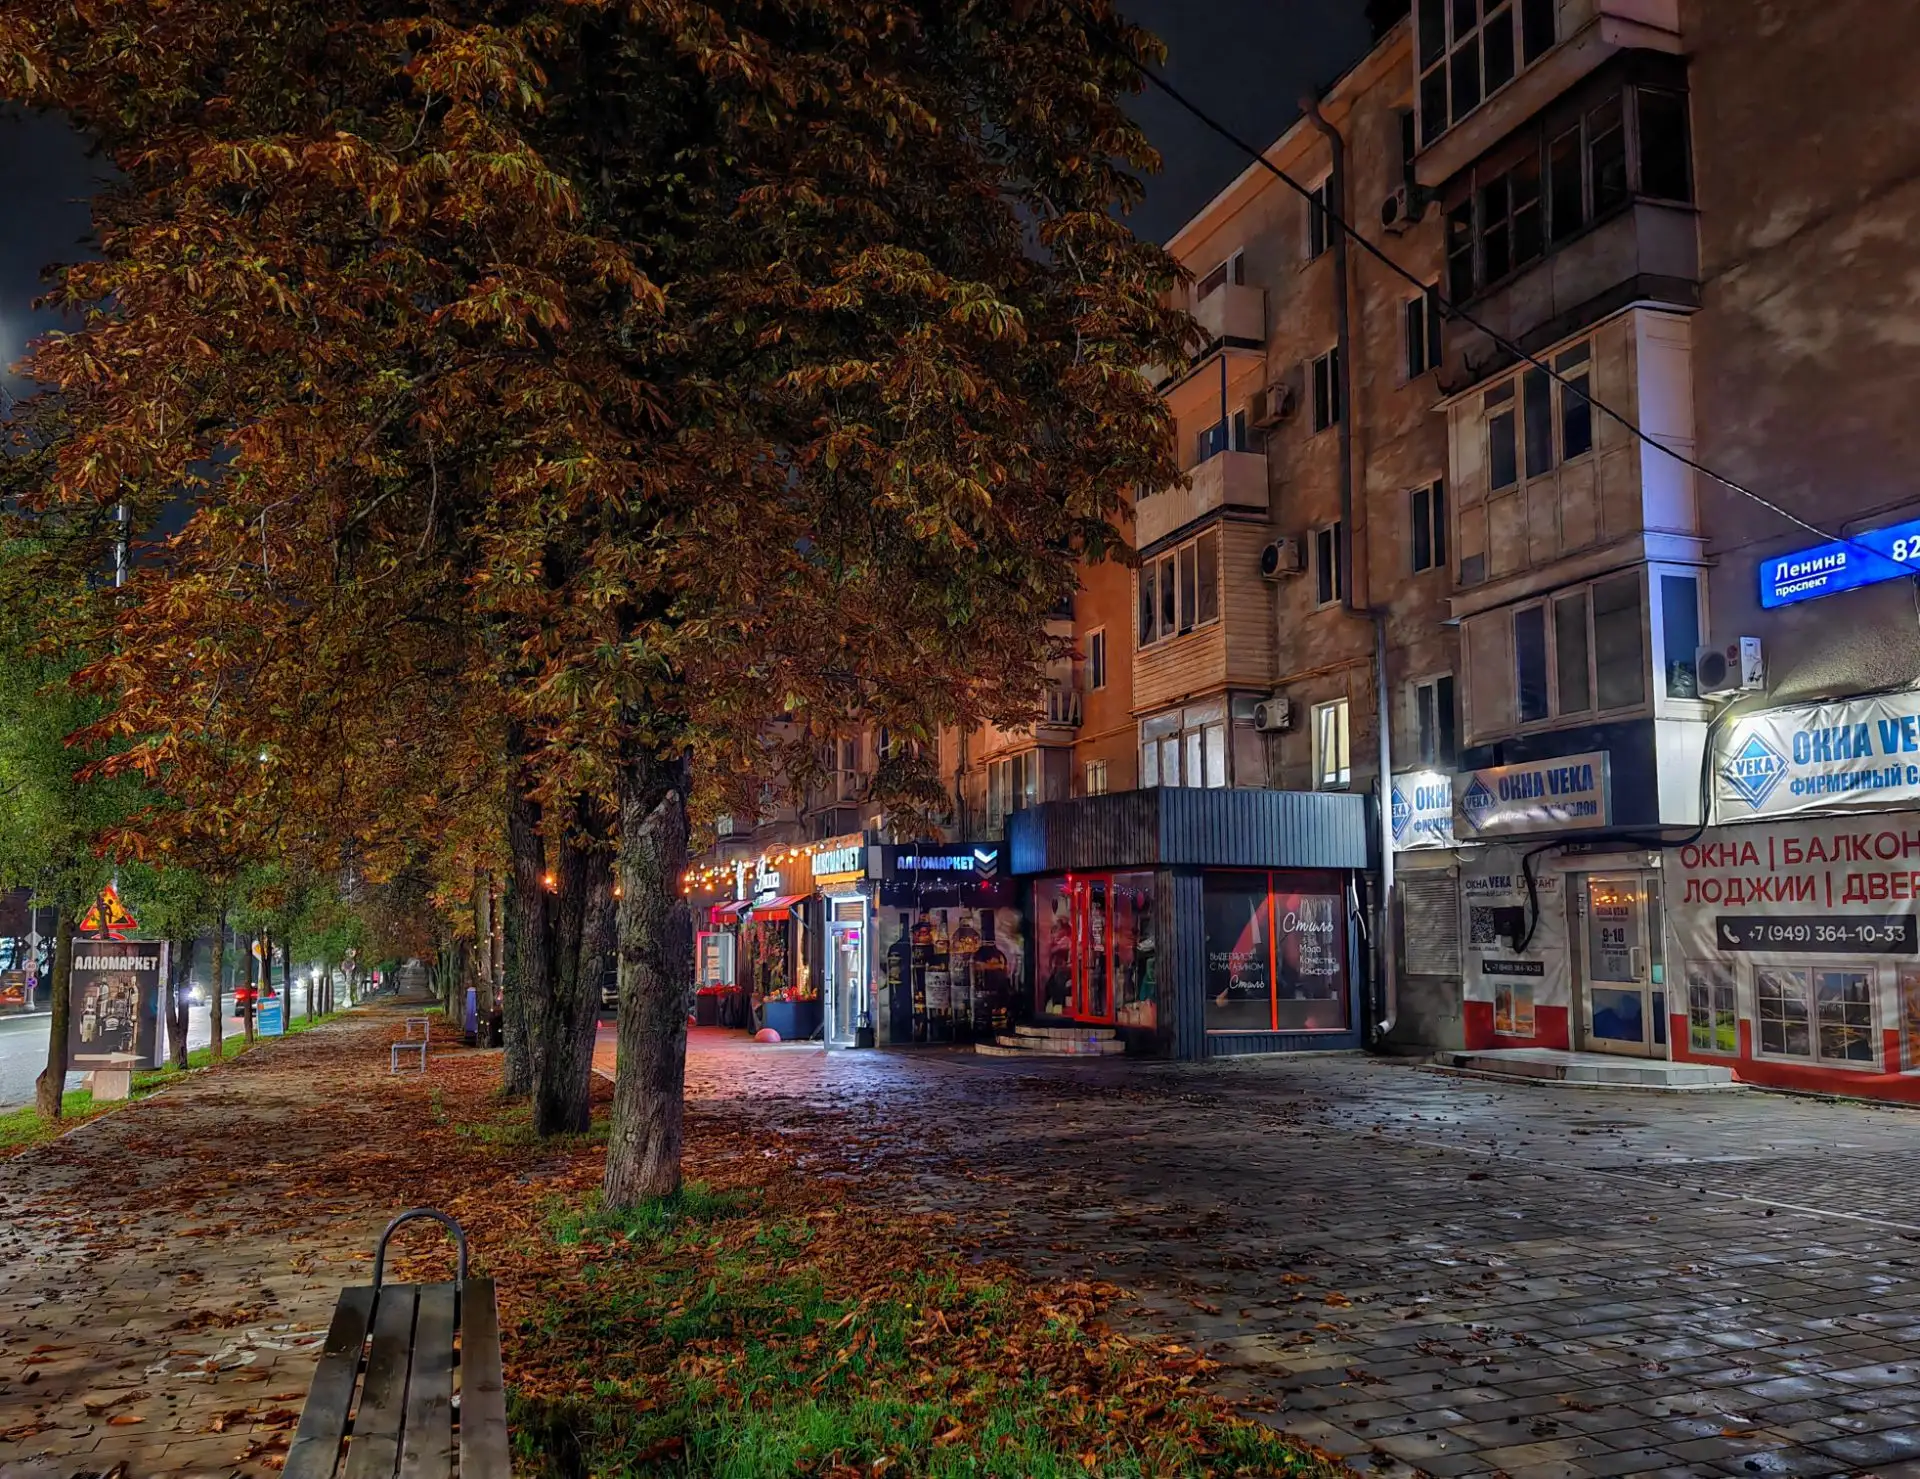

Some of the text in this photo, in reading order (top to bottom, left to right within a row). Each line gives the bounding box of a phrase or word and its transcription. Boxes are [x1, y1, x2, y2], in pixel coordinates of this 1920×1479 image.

[1893, 535, 1920, 562] 82
[1775, 552, 1847, 581] Ленина
[1775, 576, 1828, 597] проспект
[1792, 714, 1920, 766] ОКНА VE
[1735, 757, 1775, 777] VEKA
[1498, 763, 1595, 802] ОКНА VEKA
[1789, 763, 1902, 796] ФИРМЕННЫЙ
[1466, 793, 1492, 809] VEKA
[897, 856, 975, 871] АЛКОМАРКЕТ
[1680, 841, 1760, 870] ОКНА
[1465, 875, 1512, 890] ОКНА VEKA
[1683, 874, 1817, 907] ЛОДЖИИ
[1282, 911, 1334, 933] Стиль
[1748, 925, 1907, 942] +7 (949) 364-10-33
[74, 955, 158, 971] АЛКОМАРКЕТ
